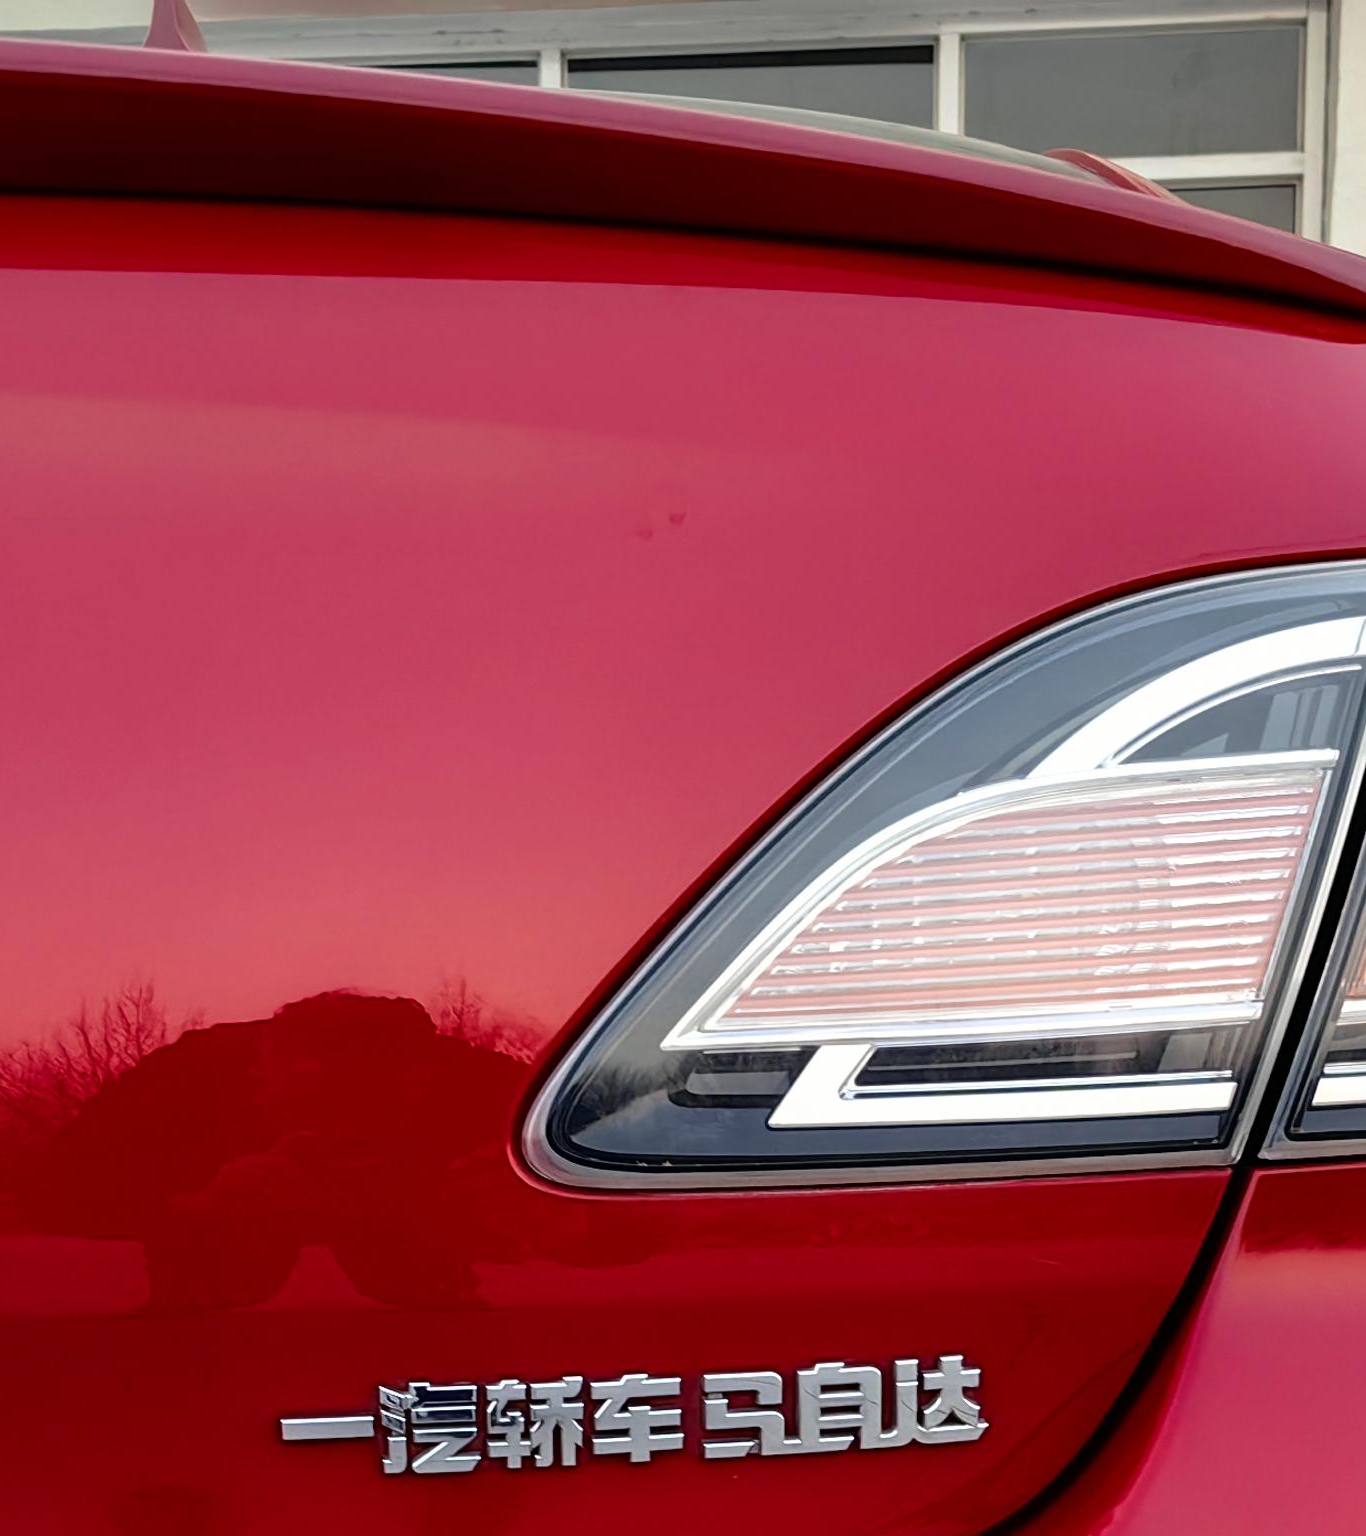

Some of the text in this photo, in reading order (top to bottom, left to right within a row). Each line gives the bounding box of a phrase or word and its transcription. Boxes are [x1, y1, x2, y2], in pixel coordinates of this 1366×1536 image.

[280, 1354, 989, 1474] 一汽轿车 马自达
